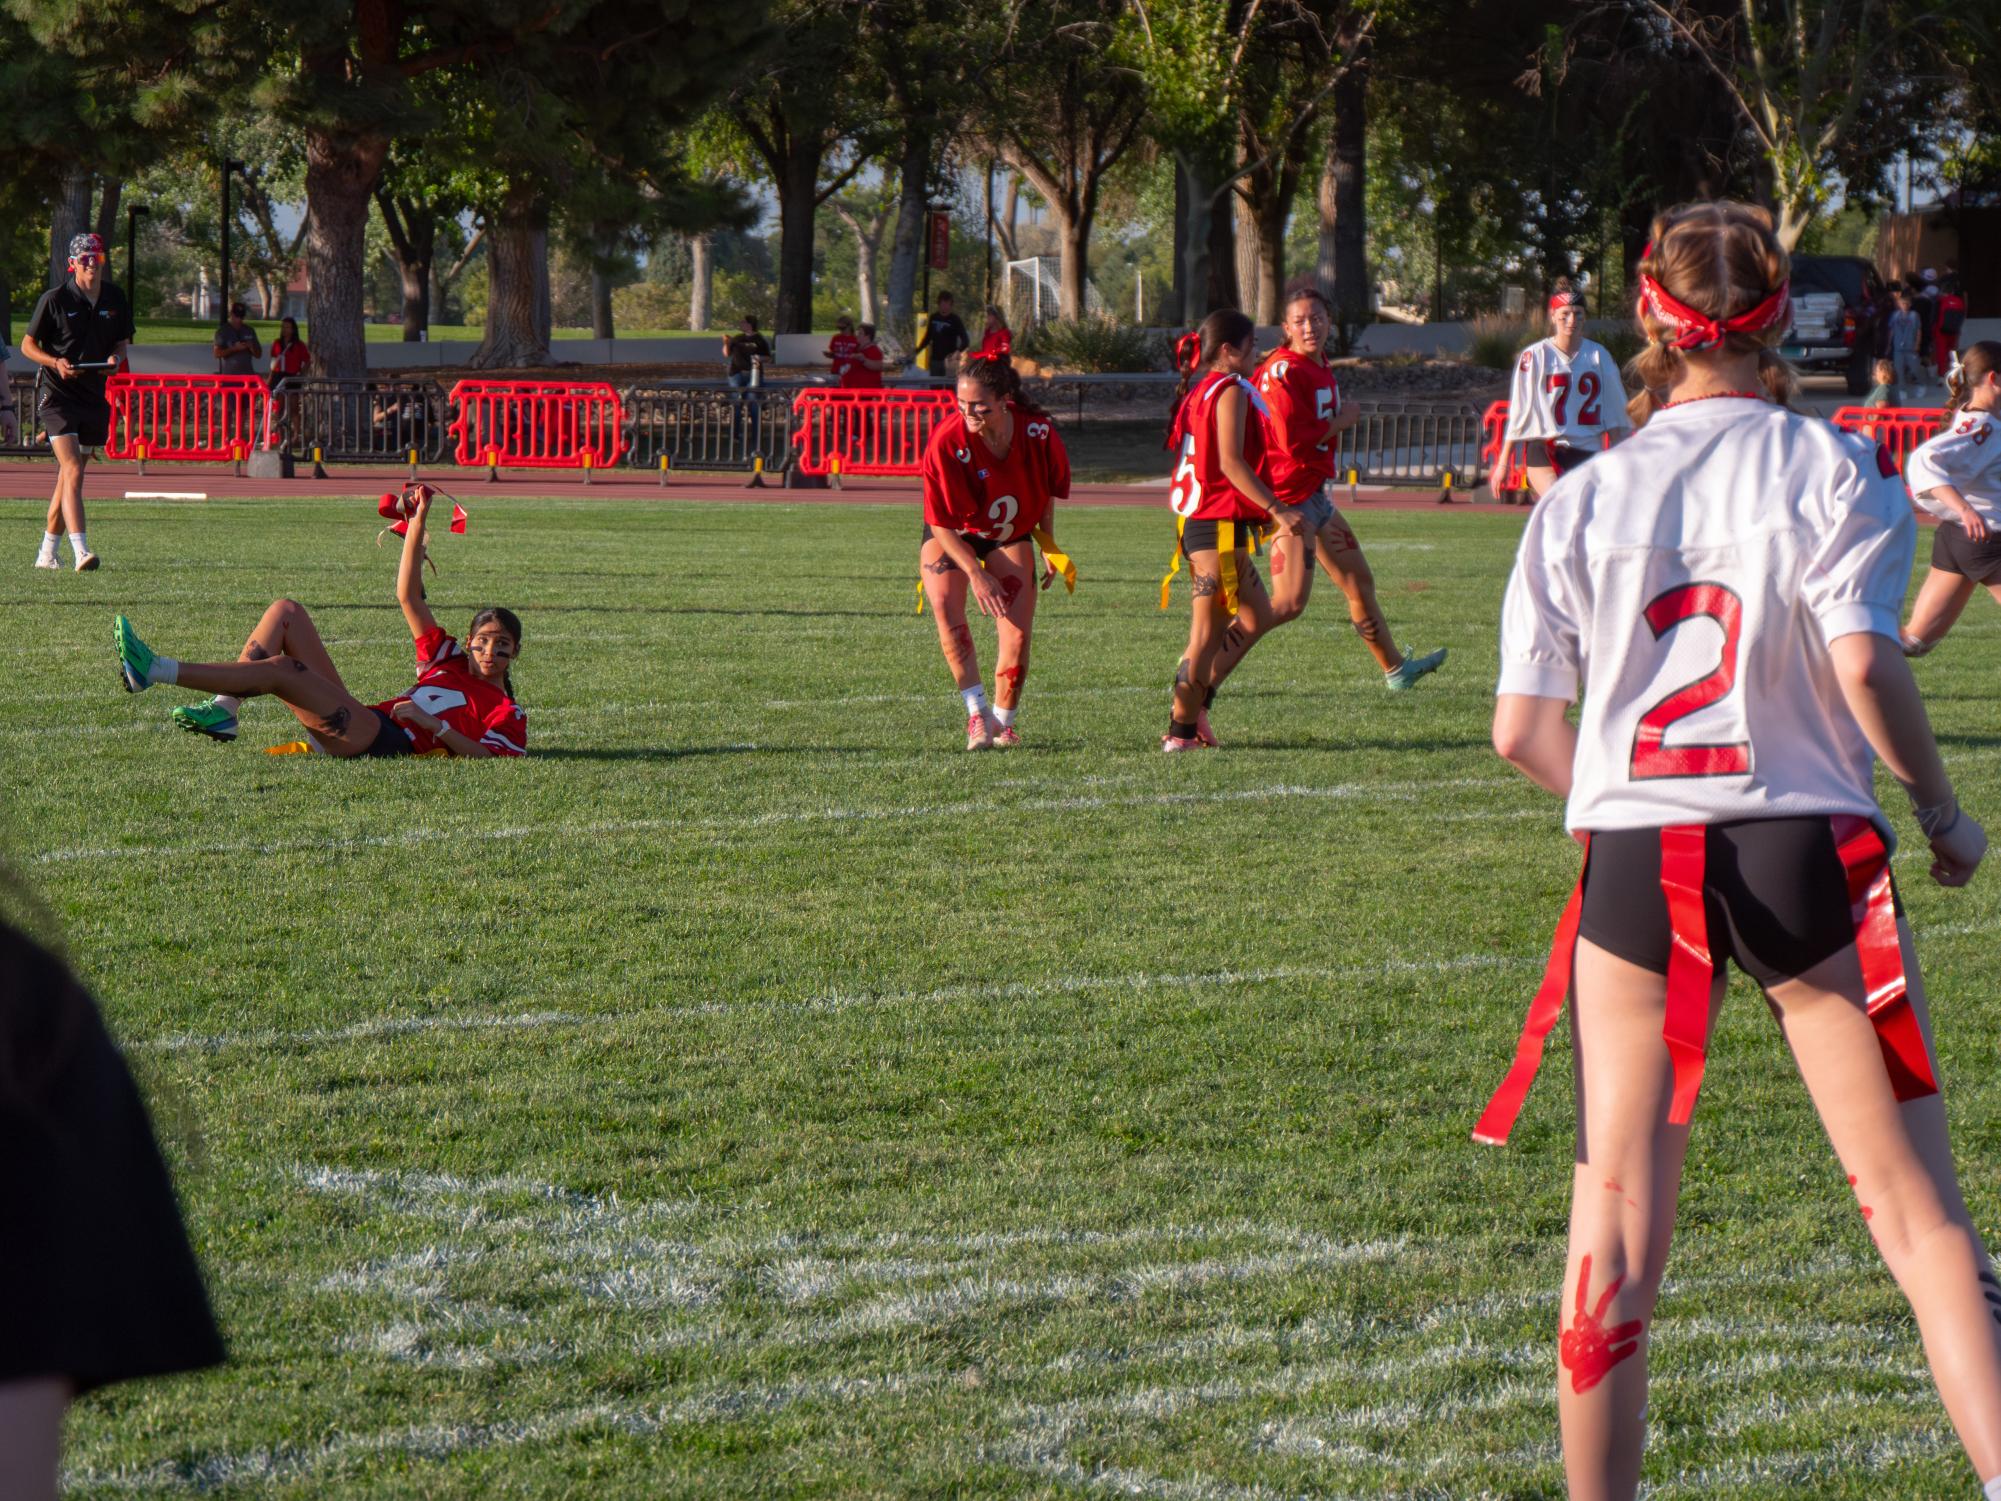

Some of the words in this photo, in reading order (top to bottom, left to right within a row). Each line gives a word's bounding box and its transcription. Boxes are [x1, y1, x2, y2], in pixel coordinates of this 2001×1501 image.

[1546, 371, 1601, 426] 72
[1027, 422, 1049, 440] 3
[988, 495, 1018, 542] 3
[1630, 581, 1753, 781] 2
